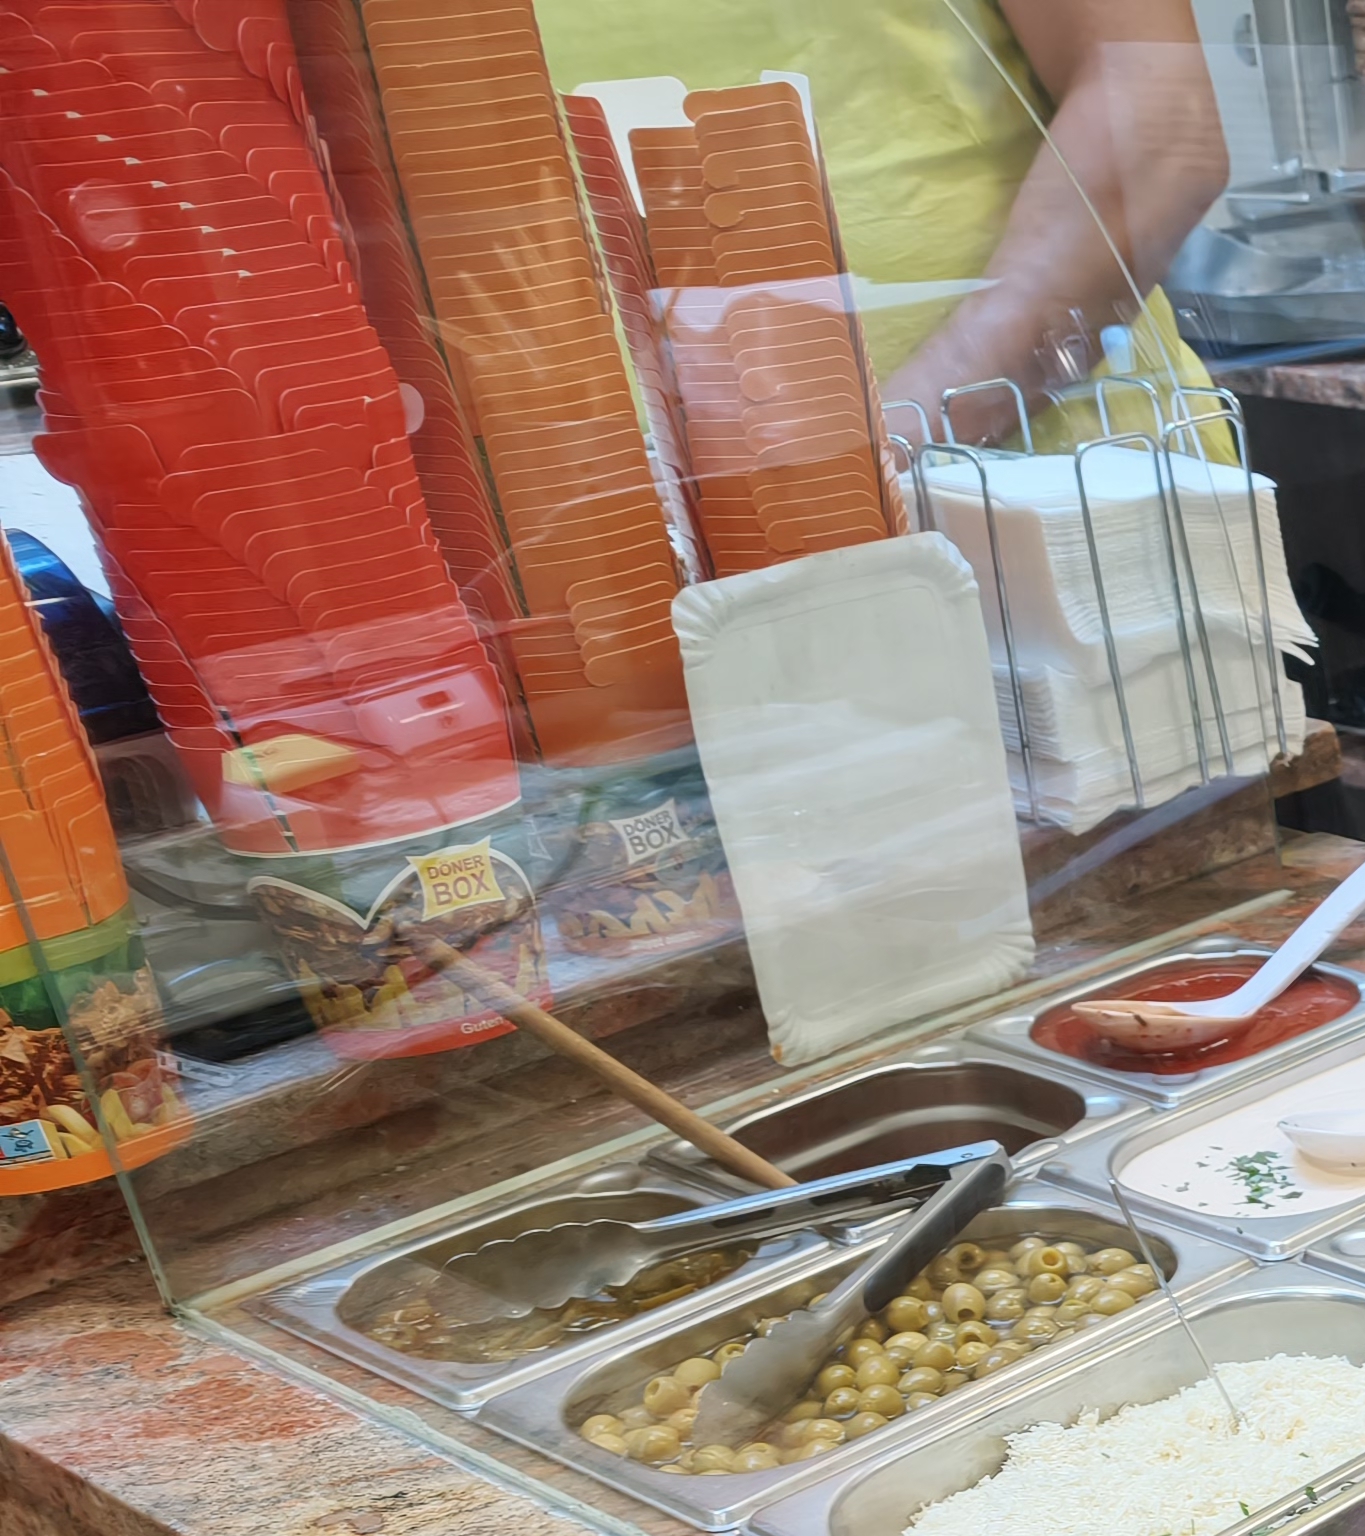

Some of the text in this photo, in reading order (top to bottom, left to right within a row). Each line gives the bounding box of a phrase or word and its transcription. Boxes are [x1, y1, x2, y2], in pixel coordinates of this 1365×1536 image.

[623, 810, 672, 836] DÖNER
[629, 821, 681, 855] BOX
[427, 855, 485, 879] DÖNER
[432, 870, 491, 906] BOX
[461, 1016, 504, 1034] Guten
